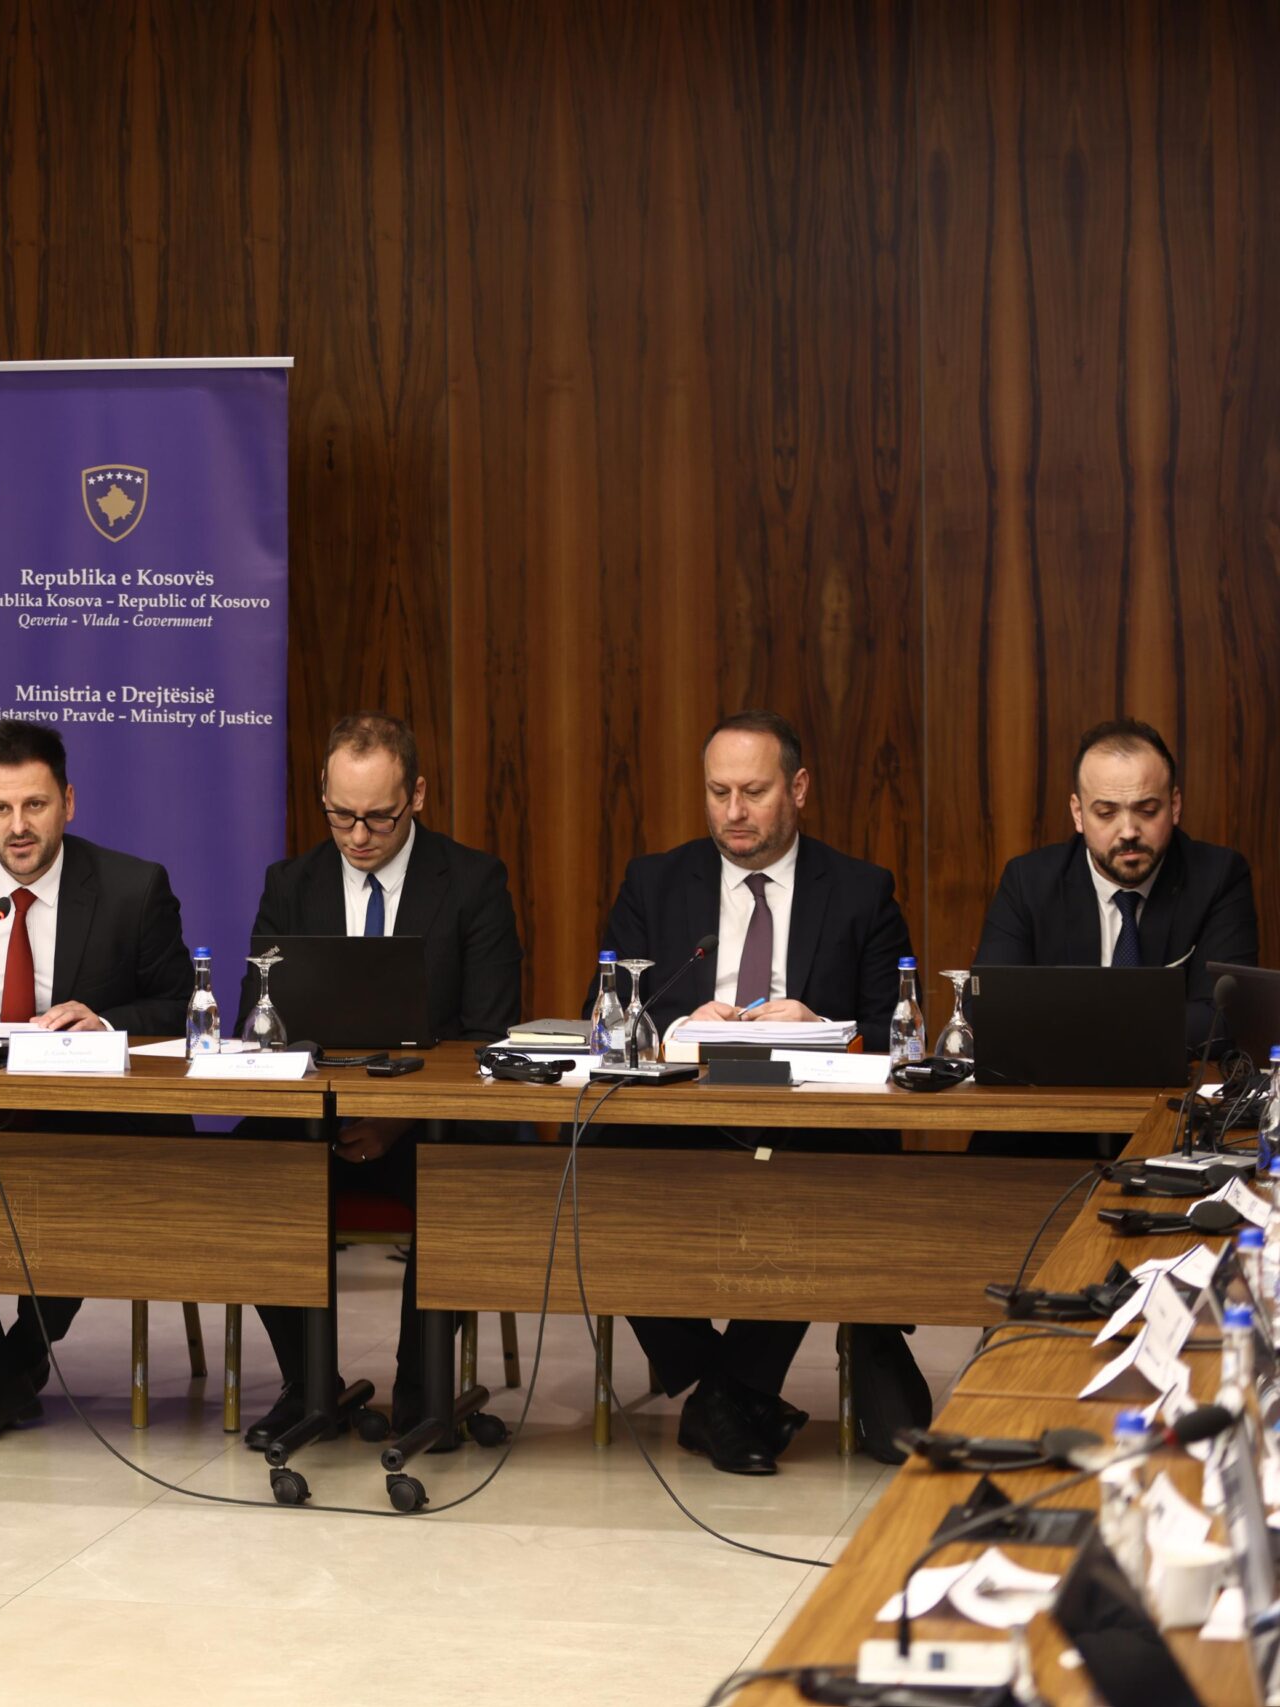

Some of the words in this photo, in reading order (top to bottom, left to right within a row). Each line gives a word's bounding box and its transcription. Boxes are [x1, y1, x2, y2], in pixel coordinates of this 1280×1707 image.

[20, 568, 117, 590] Republika
[121, 573, 132, 586] e
[136, 569, 215, 586] Kosovës
[46, 594, 103, 608] Kosova
[118, 594, 187, 611] Republic
[190, 594, 207, 608] of
[210, 595, 271, 609] Kosovo
[18, 613, 68, 630] Qeveria
[82, 613, 120, 627] Vlada
[132, 613, 214, 628] Government
[15, 685, 102, 703] Ministria
[106, 690, 117, 703] e
[121, 686, 215, 708] Drejtësisë
[62, 707, 115, 722] Pravde
[130, 708, 197, 727] Ministry
[200, 709, 217, 724] of
[218, 710, 273, 727] Justice
